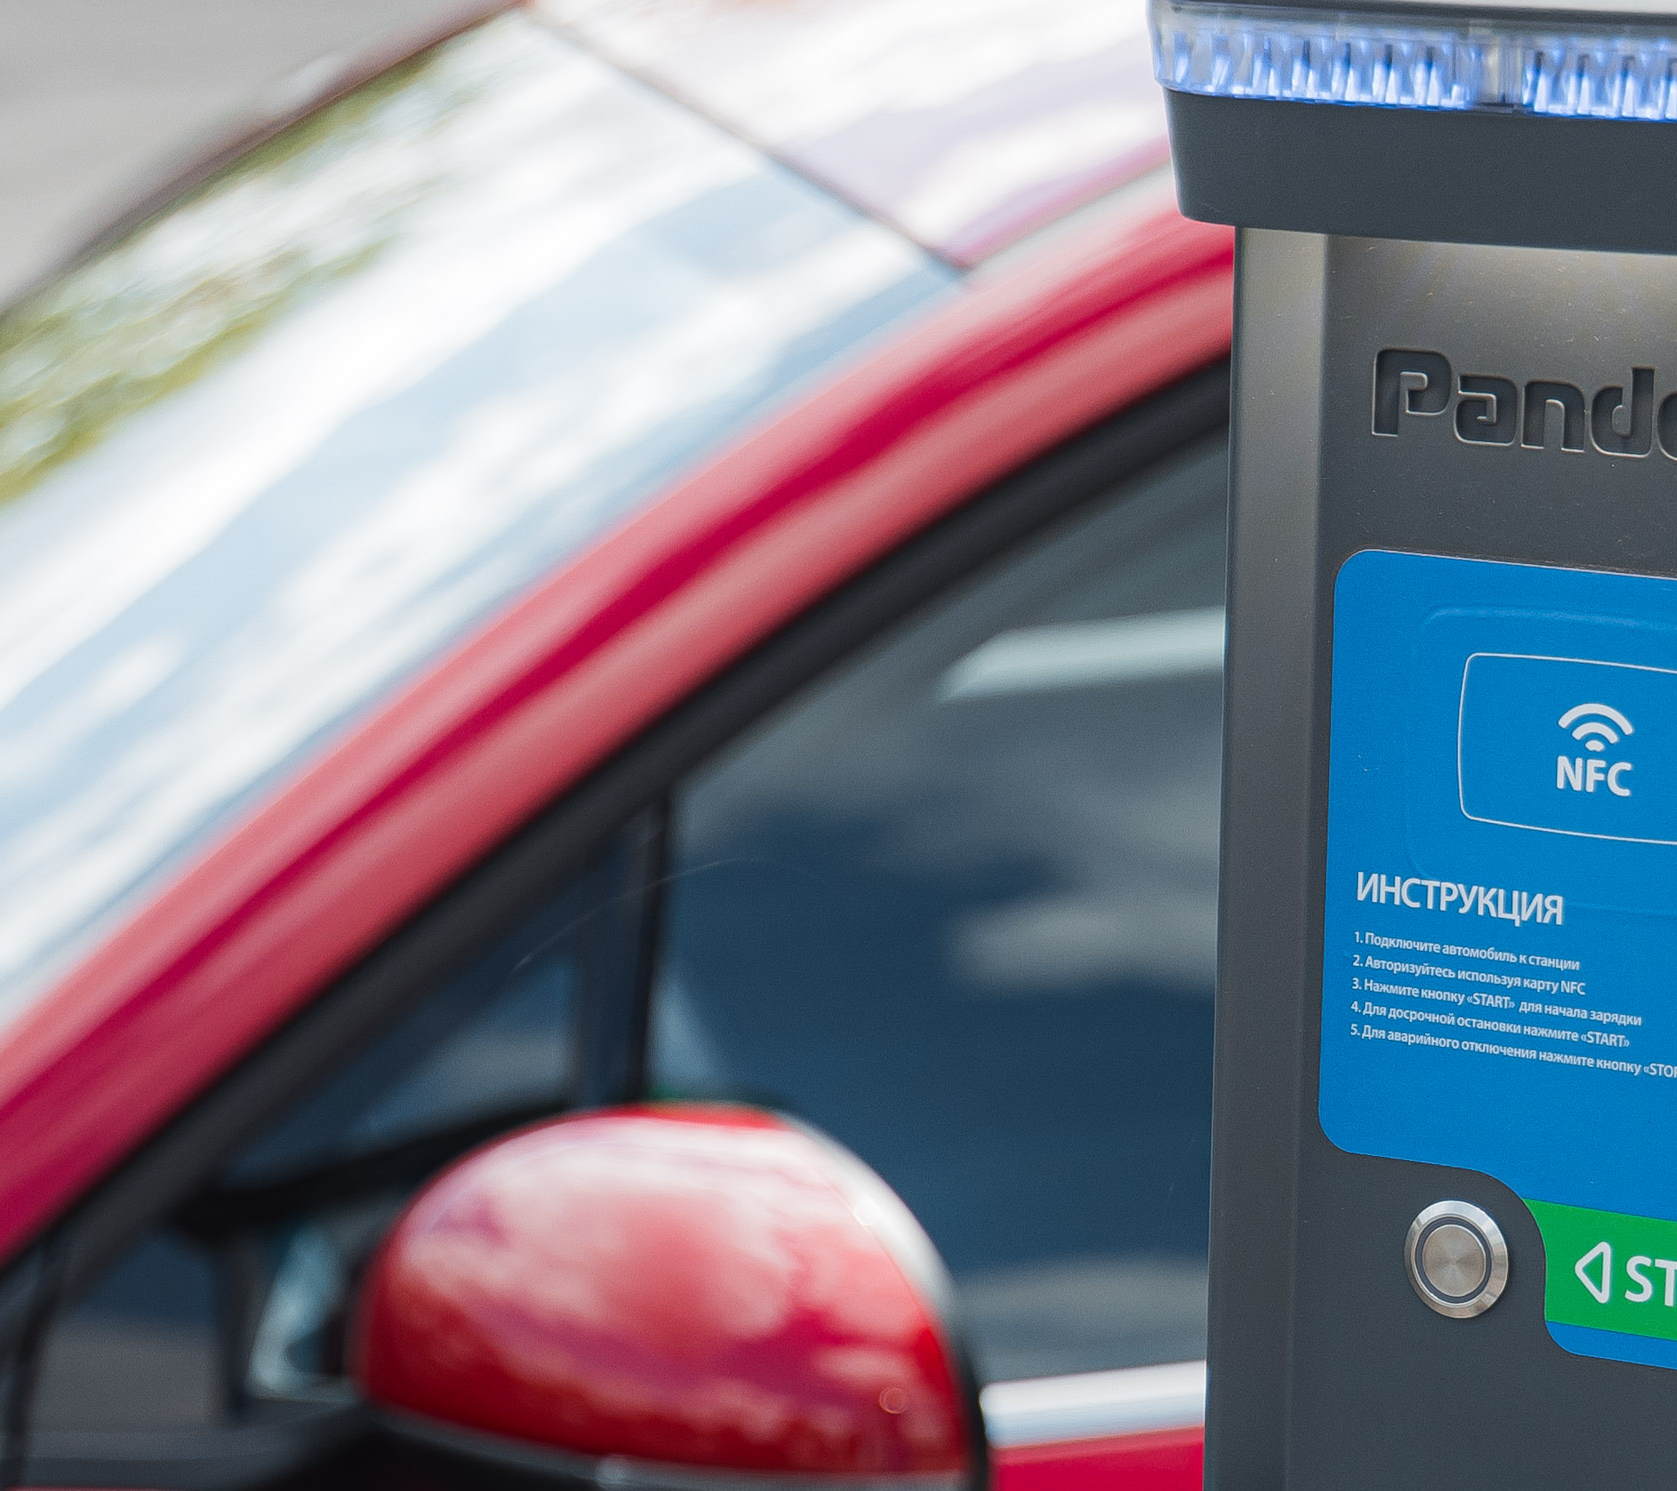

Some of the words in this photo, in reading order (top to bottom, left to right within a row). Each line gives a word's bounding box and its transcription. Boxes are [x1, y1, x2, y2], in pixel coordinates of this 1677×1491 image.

[1556, 755, 1632, 797] NFC
[1356, 871, 1564, 927] ИНСТРУКЦИЯ
[1352, 954, 1363, 967] 2.
[1365, 956, 1456, 979] Авторизуйтесь
[1457, 970, 1521, 988] используя
[1523, 978, 1559, 994] карту
[1560, 980, 1586, 995] NFC
[1354, 931, 1364, 944] 1.
[1365, 932, 1441, 954] Подключите
[1442, 944, 1518, 963] автомобиль
[1519, 954, 1527, 964] к
[1528, 955, 1581, 971] станции
[1350, 1000, 1361, 1013] 4.
[1363, 1002, 1387, 1017] Для
[1388, 1007, 1455, 1025] досрочной
[1456, 1016, 1521, 1034] остановки
[1523, 1025, 1579, 1042] нажмите
[1580, 1030, 1630, 1047] «START»
[1351, 977, 1362, 990] 3.
[1363, 978, 1419, 997] Нажмите
[1421, 988, 1465, 1005] кнопку
[1467, 992, 1515, 1009] «START»
[1518, 1001, 1542, 1014] для
[1544, 1005, 1587, 1019] начала
[1589, 1010, 1642, 1026] зарядки
[1350, 1023, 1361, 1036] 5.
[1362, 1024, 1386, 1040] Для
[1387, 1030, 1459, 1049] аварийного
[1461, 1041, 1537, 1060] отключения
[1538, 1051, 1594, 1067] нажмите
[1596, 1057, 1641, 1076] кнопку
